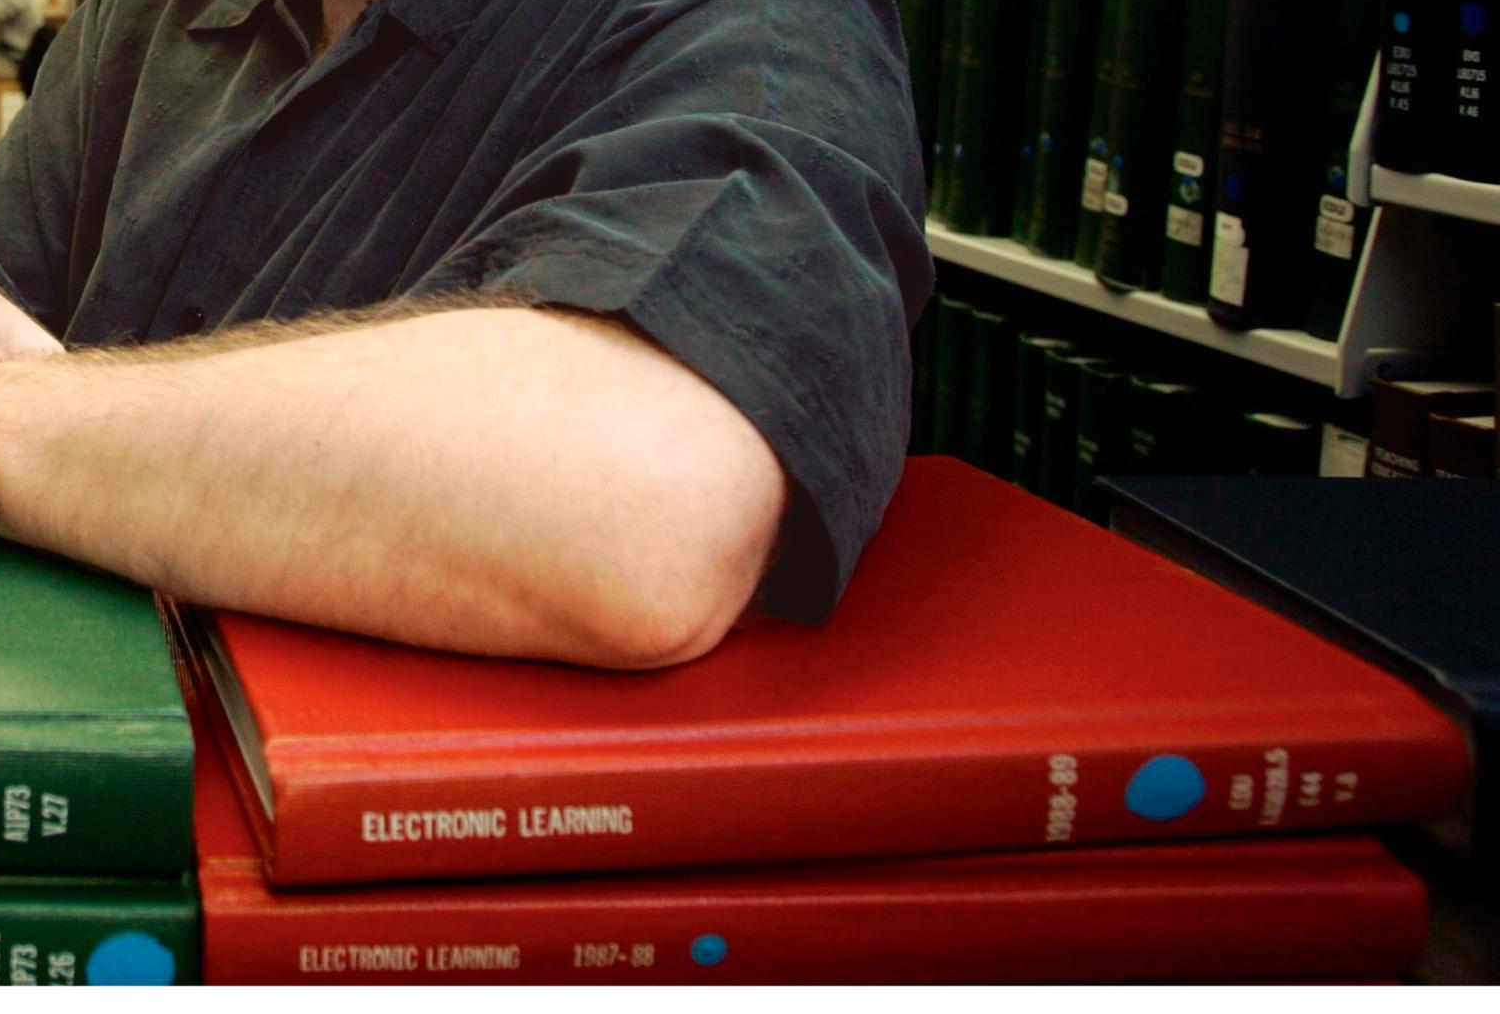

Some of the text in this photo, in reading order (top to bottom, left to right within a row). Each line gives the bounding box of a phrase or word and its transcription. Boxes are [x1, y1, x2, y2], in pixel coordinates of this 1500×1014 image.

[3, 785, 31, 843] A1P73
[41, 792, 68, 837] V.27
[361, 805, 634, 843] ELECTRONIC LEARNING
[299, 943, 655, 972] ELECTRONIC LEARNING 1987-88
